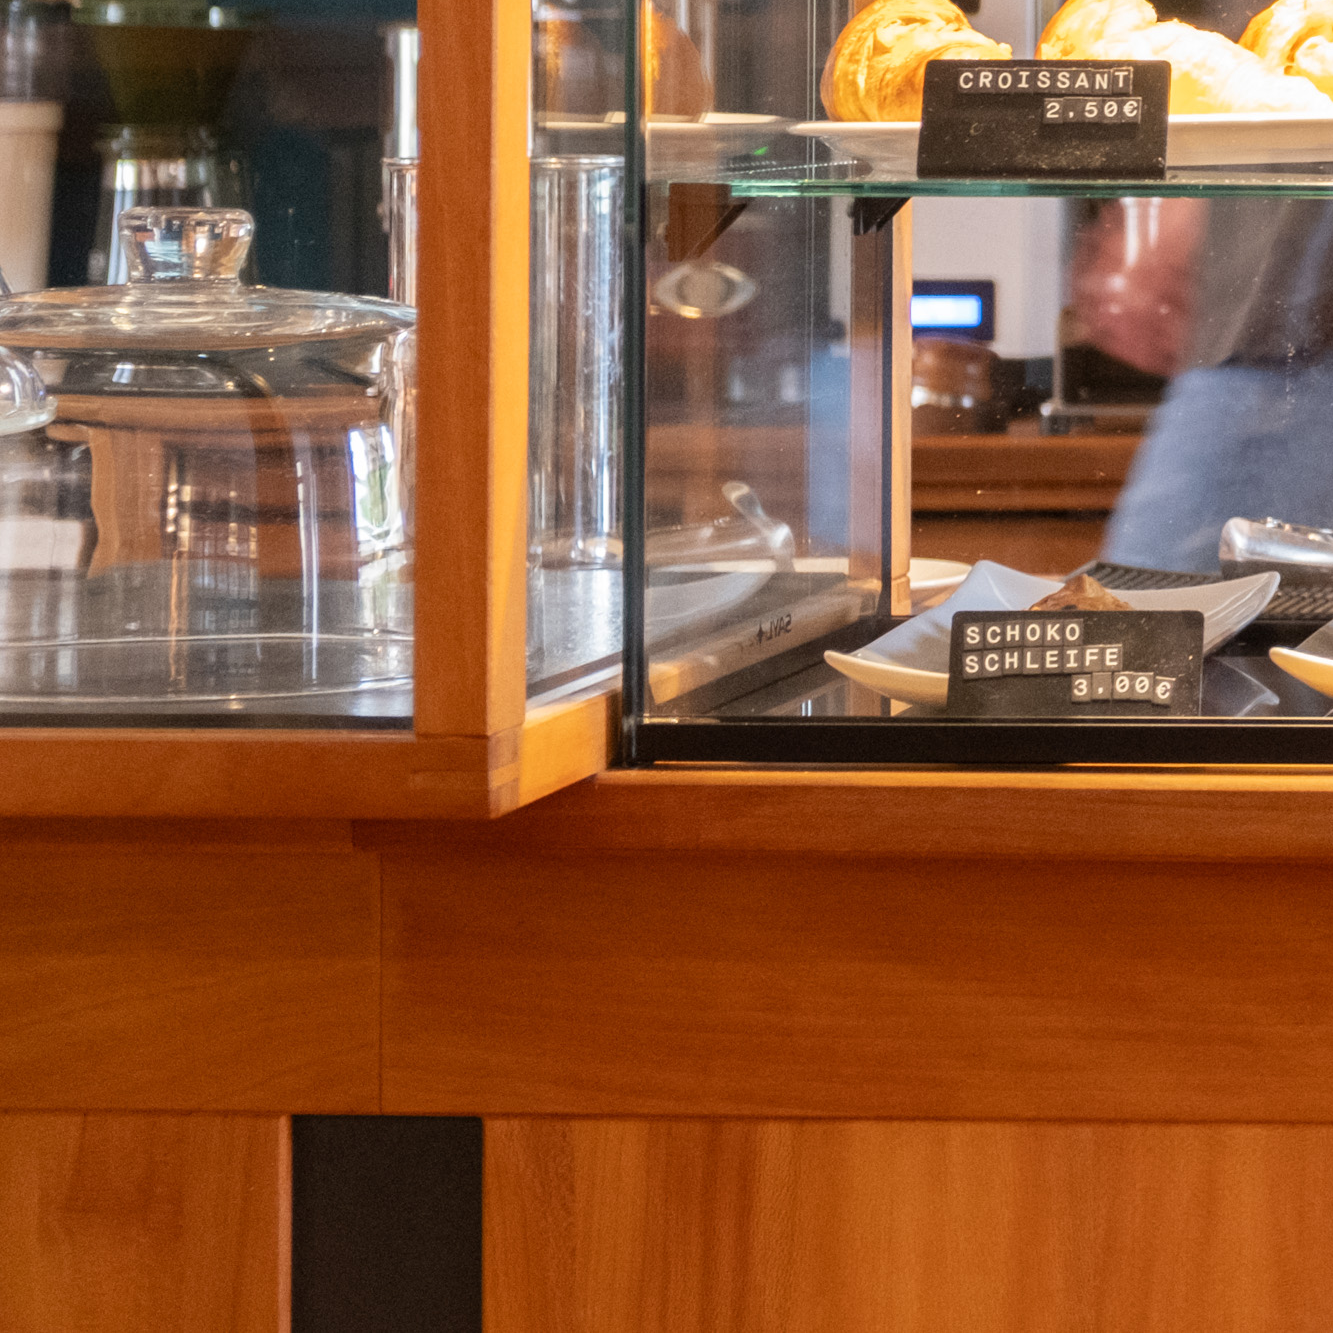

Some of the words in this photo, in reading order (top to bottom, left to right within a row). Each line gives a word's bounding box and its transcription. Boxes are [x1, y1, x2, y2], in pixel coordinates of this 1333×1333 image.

[958, 69, 1131, 93] CROISSANT
[1045, 99, 1140, 120] 2,50€
[965, 620, 1081, 646] SCHOKO
[964, 646, 1120, 676] SCHLEIFE
[1073, 673, 1172, 702] 3,00€
